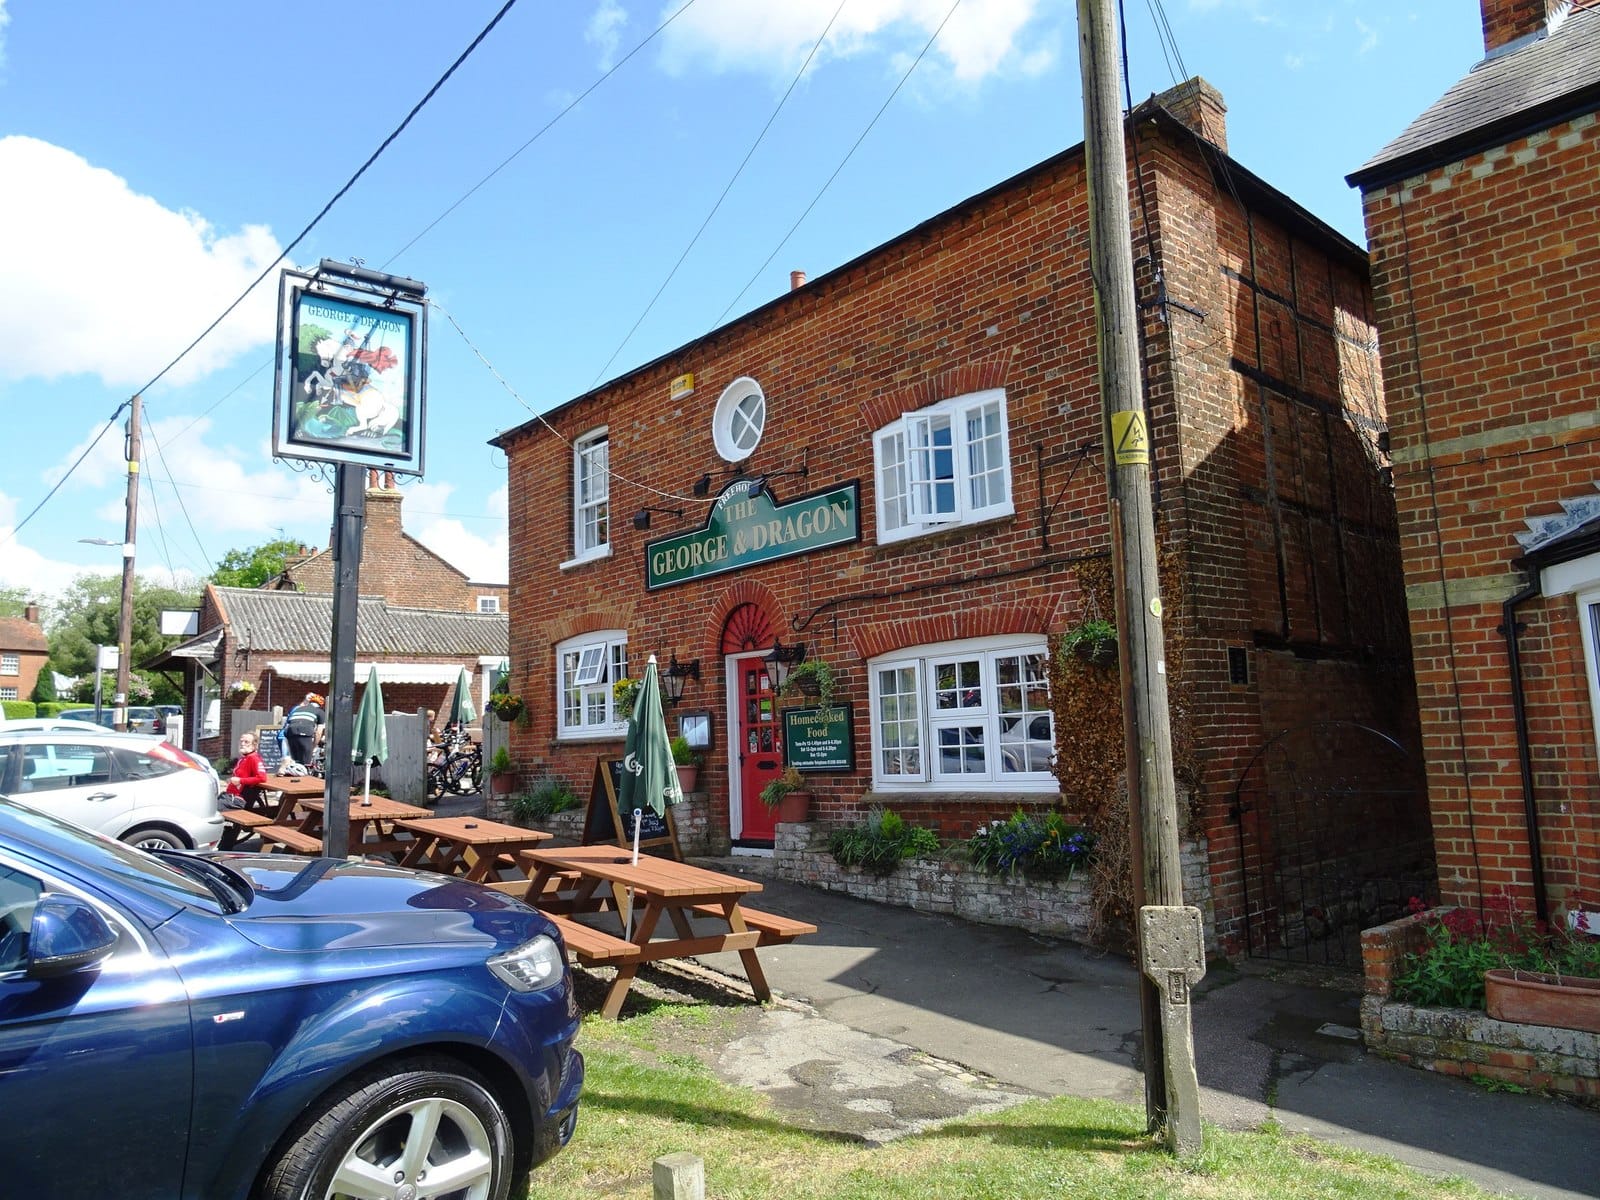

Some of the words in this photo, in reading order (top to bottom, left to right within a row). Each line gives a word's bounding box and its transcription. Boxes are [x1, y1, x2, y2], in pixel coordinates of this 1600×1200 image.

[308, 305, 350, 323] GEORGE
[361, 315, 401, 333] DRAGON
[717, 483, 751, 510] FREEHO
[723, 498, 757, 523] THE
[653, 534, 728, 576] GEORGE
[733, 529, 747, 555] &
[753, 500, 848, 551] DRAGON
[807, 727, 828, 738] Food
